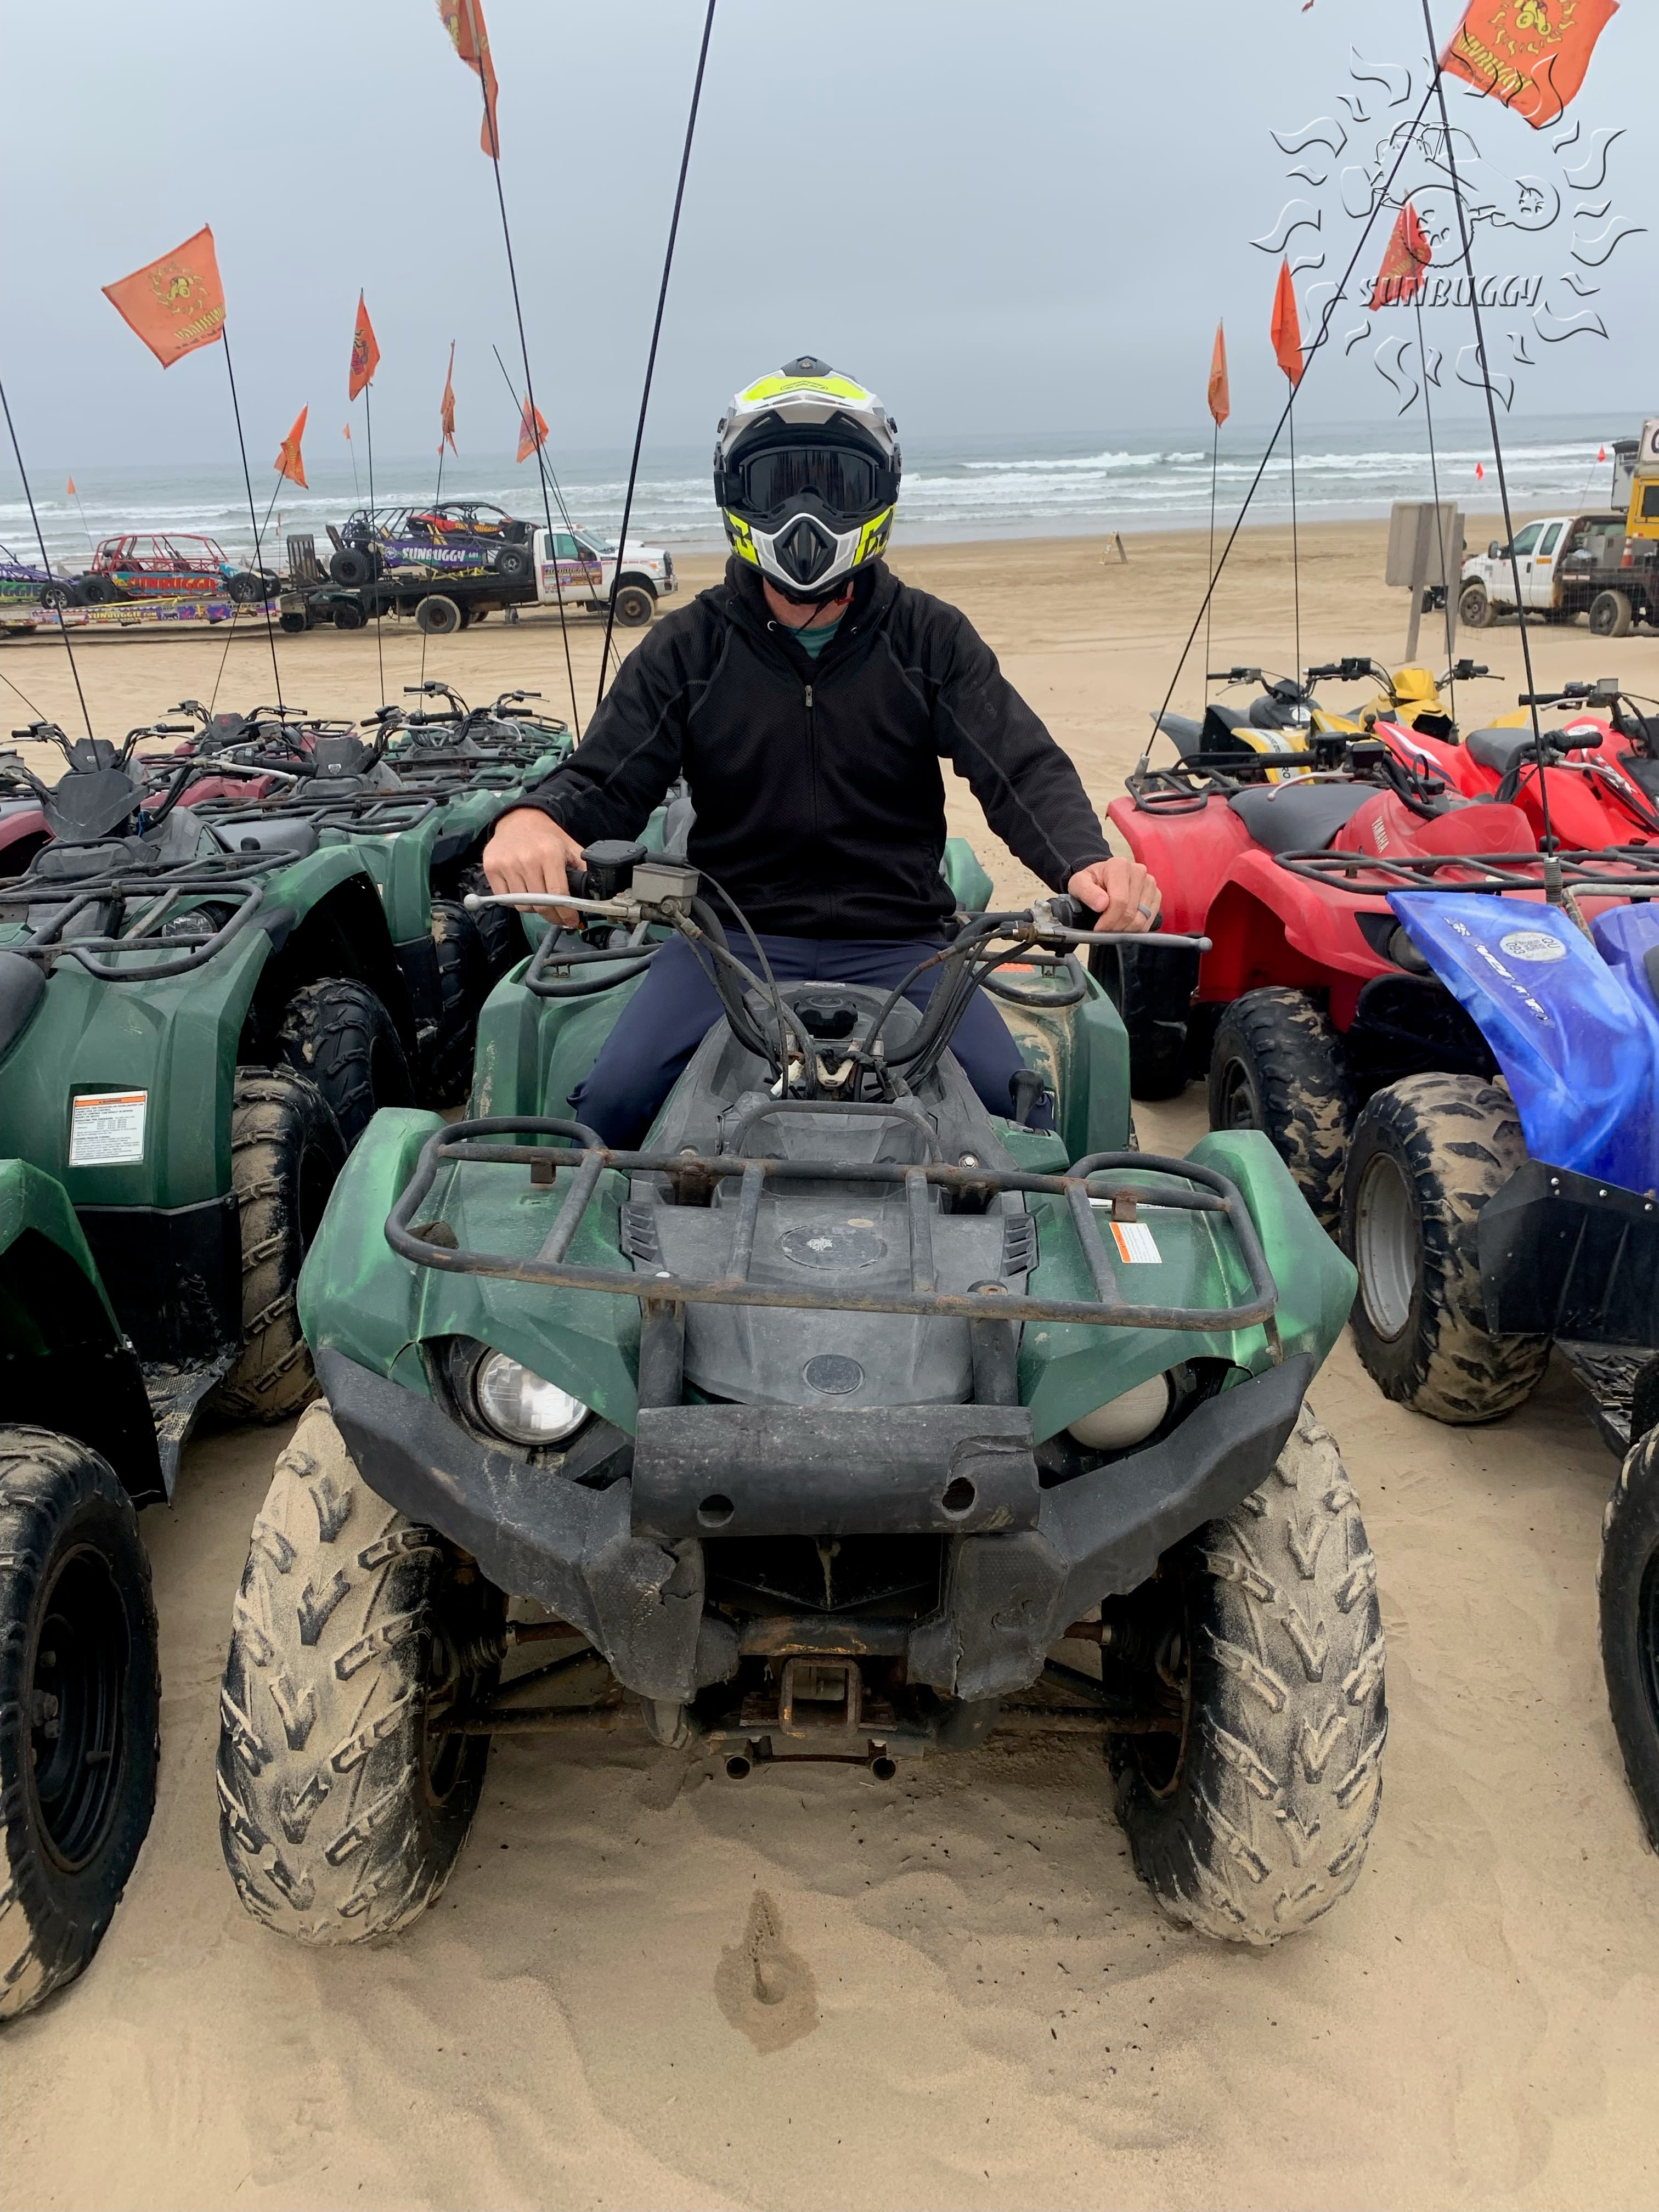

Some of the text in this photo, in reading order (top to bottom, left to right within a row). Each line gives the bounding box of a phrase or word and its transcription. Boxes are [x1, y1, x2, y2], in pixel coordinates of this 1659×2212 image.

[402, 546, 466, 562] SUNBUGGY
[1372, 816, 1389, 854] YAMAHA
[1505, 942, 1525, 955] 093
[1542, 938, 1561, 949] QU
